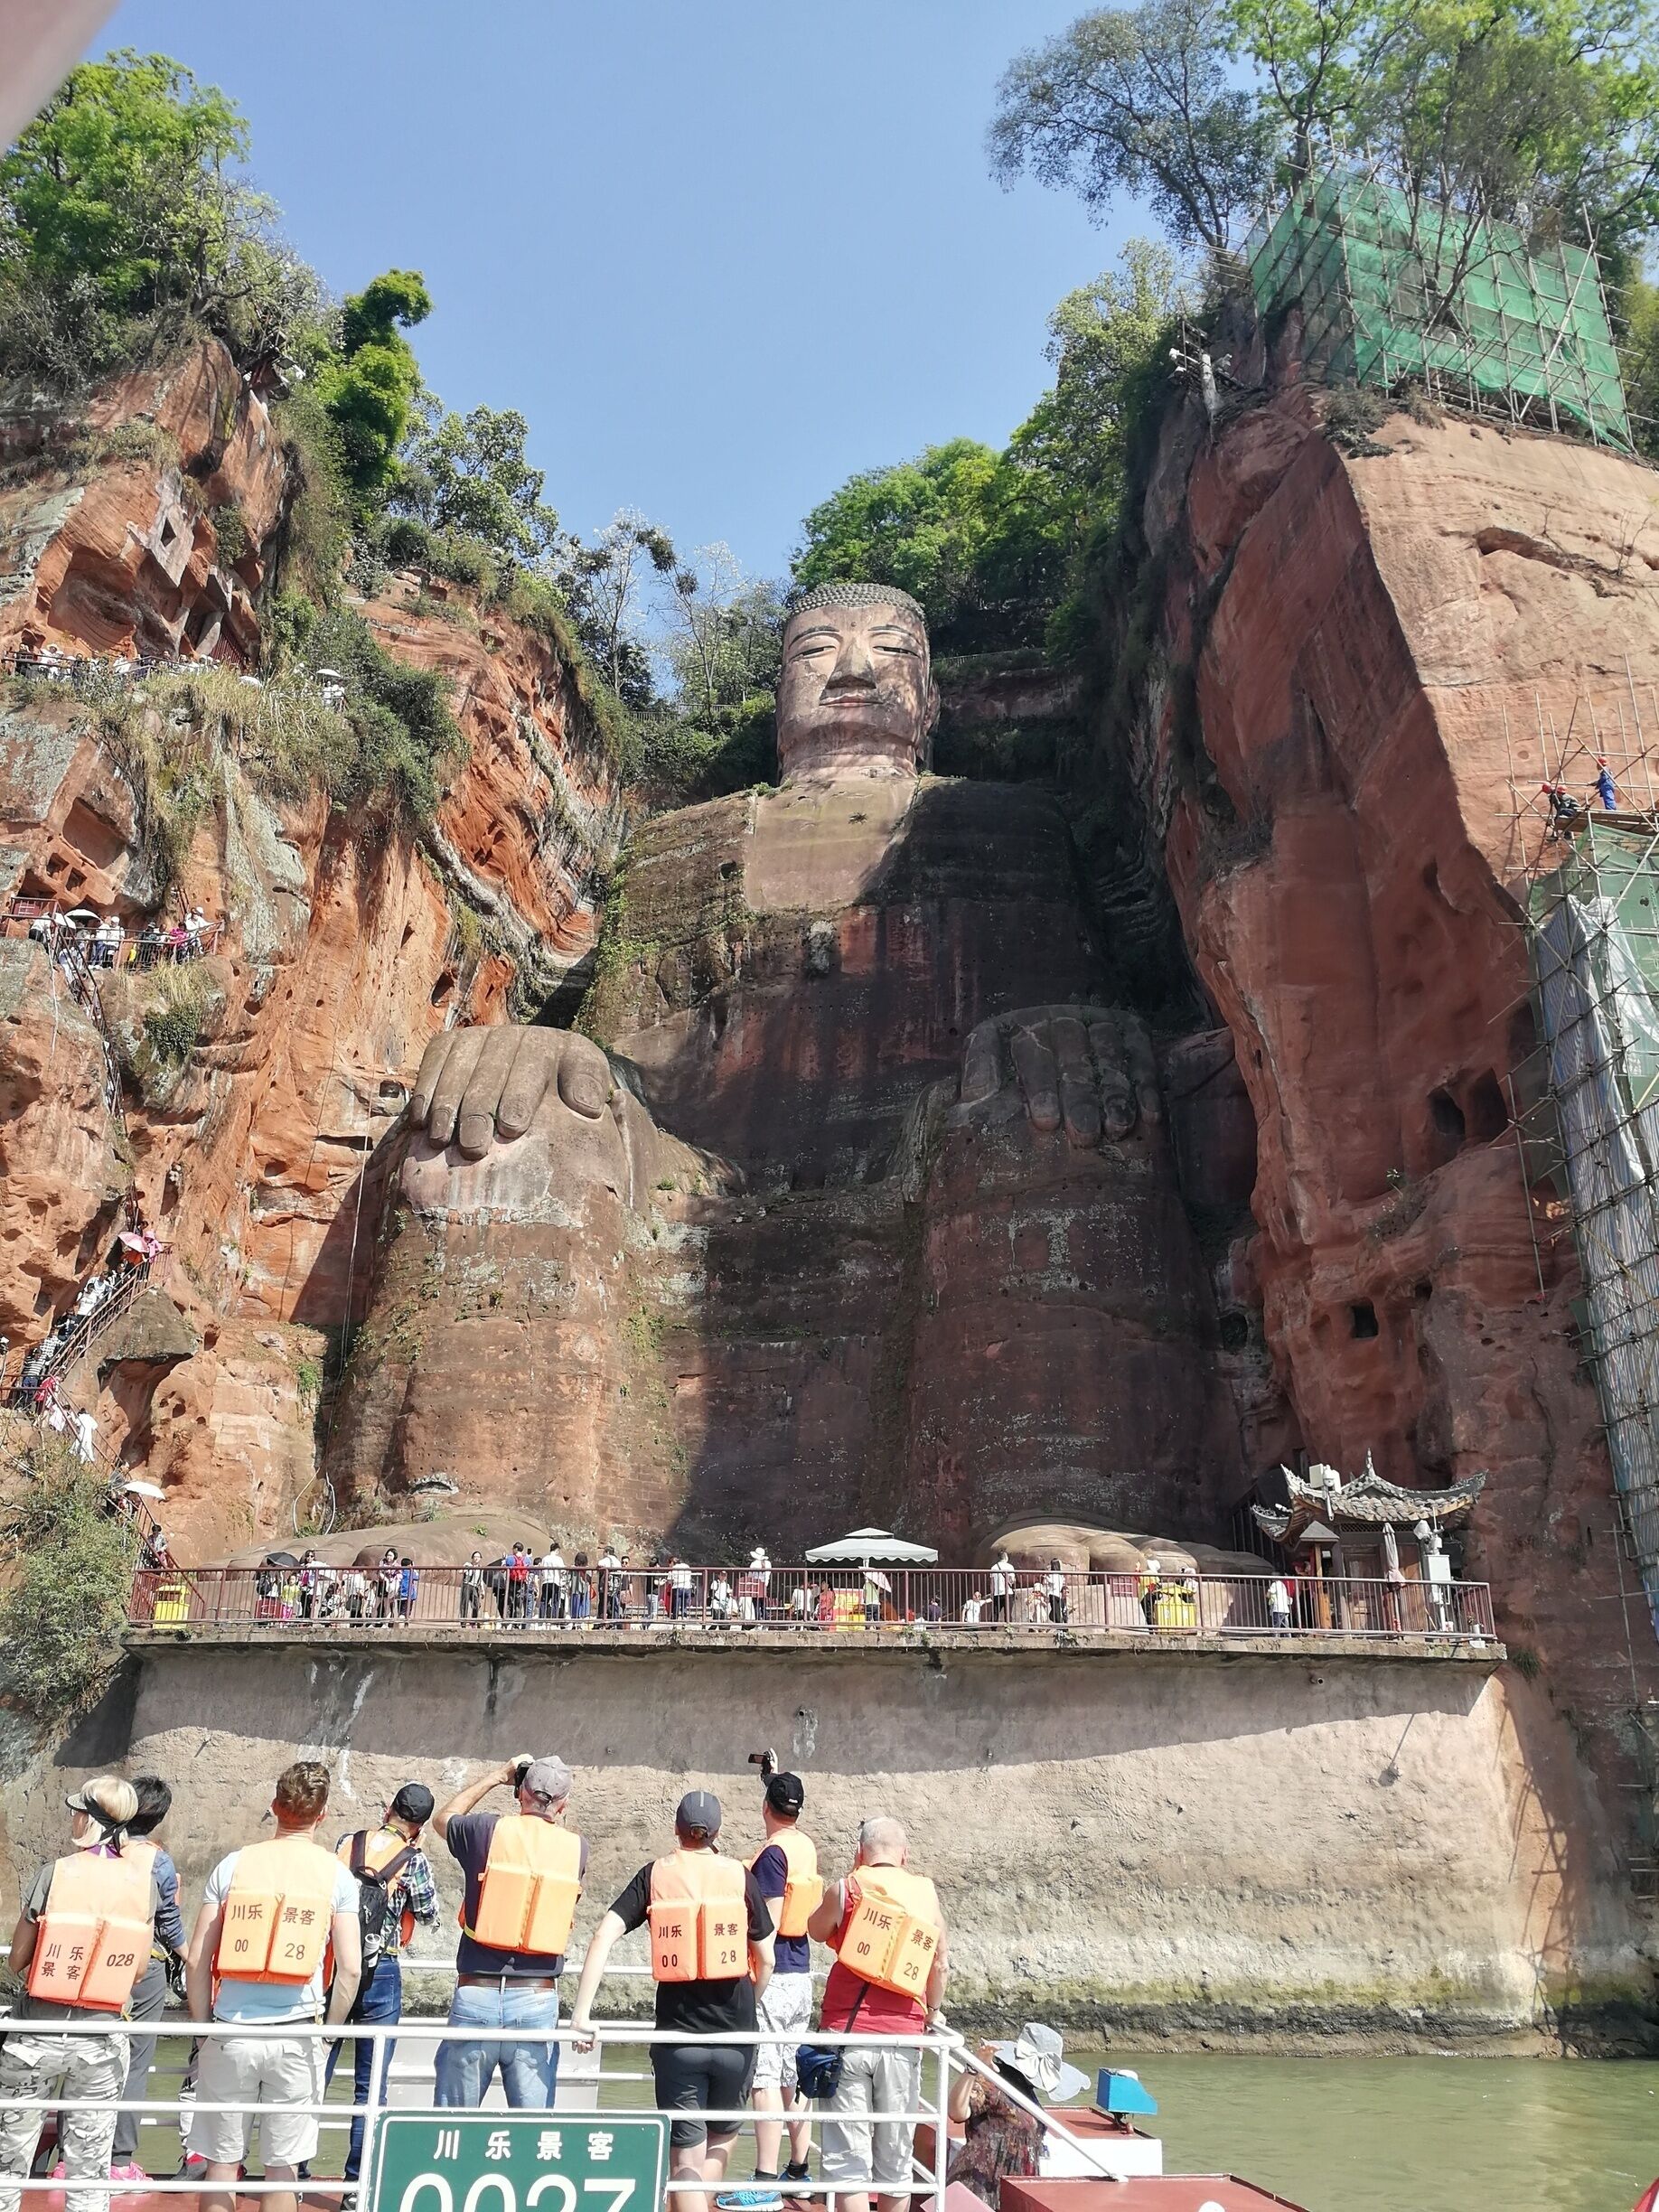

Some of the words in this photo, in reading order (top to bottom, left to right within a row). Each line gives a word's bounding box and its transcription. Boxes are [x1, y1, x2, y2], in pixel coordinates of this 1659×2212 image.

[231, 1904, 263, 1920] 川乐
[282, 1907, 315, 1926] 景客
[658, 1924, 682, 1939] 川乐
[714, 1923, 738, 1936] 景客
[863, 1907, 893, 1931] 川乐
[911, 1928, 934, 1952] 景客
[45, 1943, 84, 1962] 川乐
[234, 1939, 249, 1953] 00
[284, 1943, 305, 1960] 28
[661, 1954, 679, 1968] 00
[720, 1950, 737, 1964] 28
[106, 1953, 136, 1967] 028
[857, 1941, 871, 1956] 00
[903, 1962, 920, 1981] 28
[41, 1961, 81, 1981] 景客
[433, 2129, 614, 2160] 川乐景客
